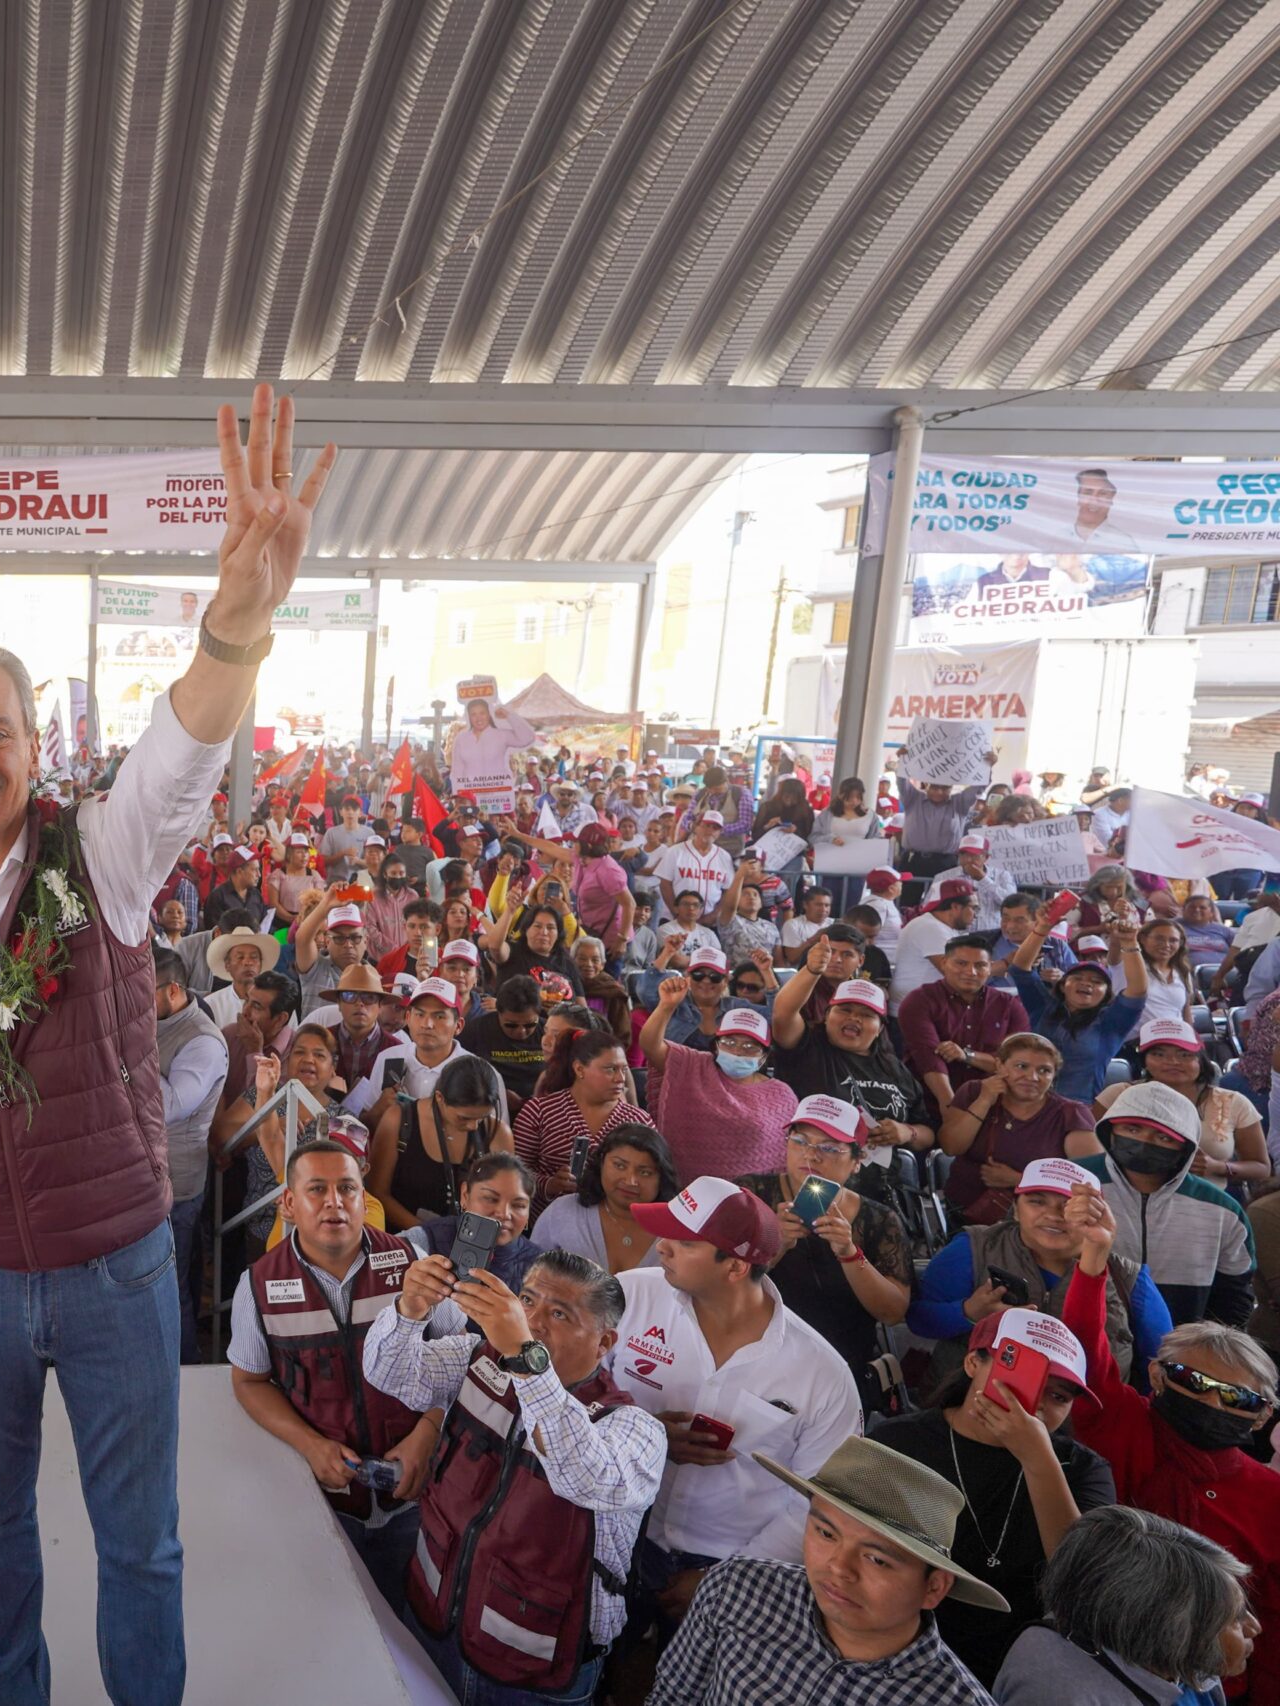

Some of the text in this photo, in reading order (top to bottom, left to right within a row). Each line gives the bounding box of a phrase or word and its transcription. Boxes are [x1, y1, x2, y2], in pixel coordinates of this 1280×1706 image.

[165, 478, 227, 492] moren
[951, 471, 1038, 488] CIUDAD
[1216, 473, 1280, 495] PEP
[146, 497, 179, 508] POR
[183, 497, 203, 508] LA
[955, 493, 1030, 510] TODAS
[160, 511, 227, 523] DEL FUT
[925, 515, 1012, 532] TODOS”
[16, 526, 81, 536] MUNICIPAL
[1192, 531, 1264, 541] PRESIDENTE
[117, 588, 159, 598] FUTURO
[986, 584, 1050, 601] PEPE
[105, 597, 119, 605] DE
[121, 598, 133, 606] LA
[954, 598, 1084, 618] CHEDRAUI
[272, 607, 309, 618] RAUI
[935, 671, 978, 684] VOTA
[459, 687, 494, 698] VOTA
[888, 693, 1027, 718] ARMENTA
[927, 749, 967, 779] VAMOS
[473, 774, 511, 783] ARIANNA
[371, 1251, 405, 1263] morena
[385, 1272, 402, 1286] 4T
[627, 1335, 676, 1360] ARMENTA
[1031, 1338, 1068, 1359] morena
